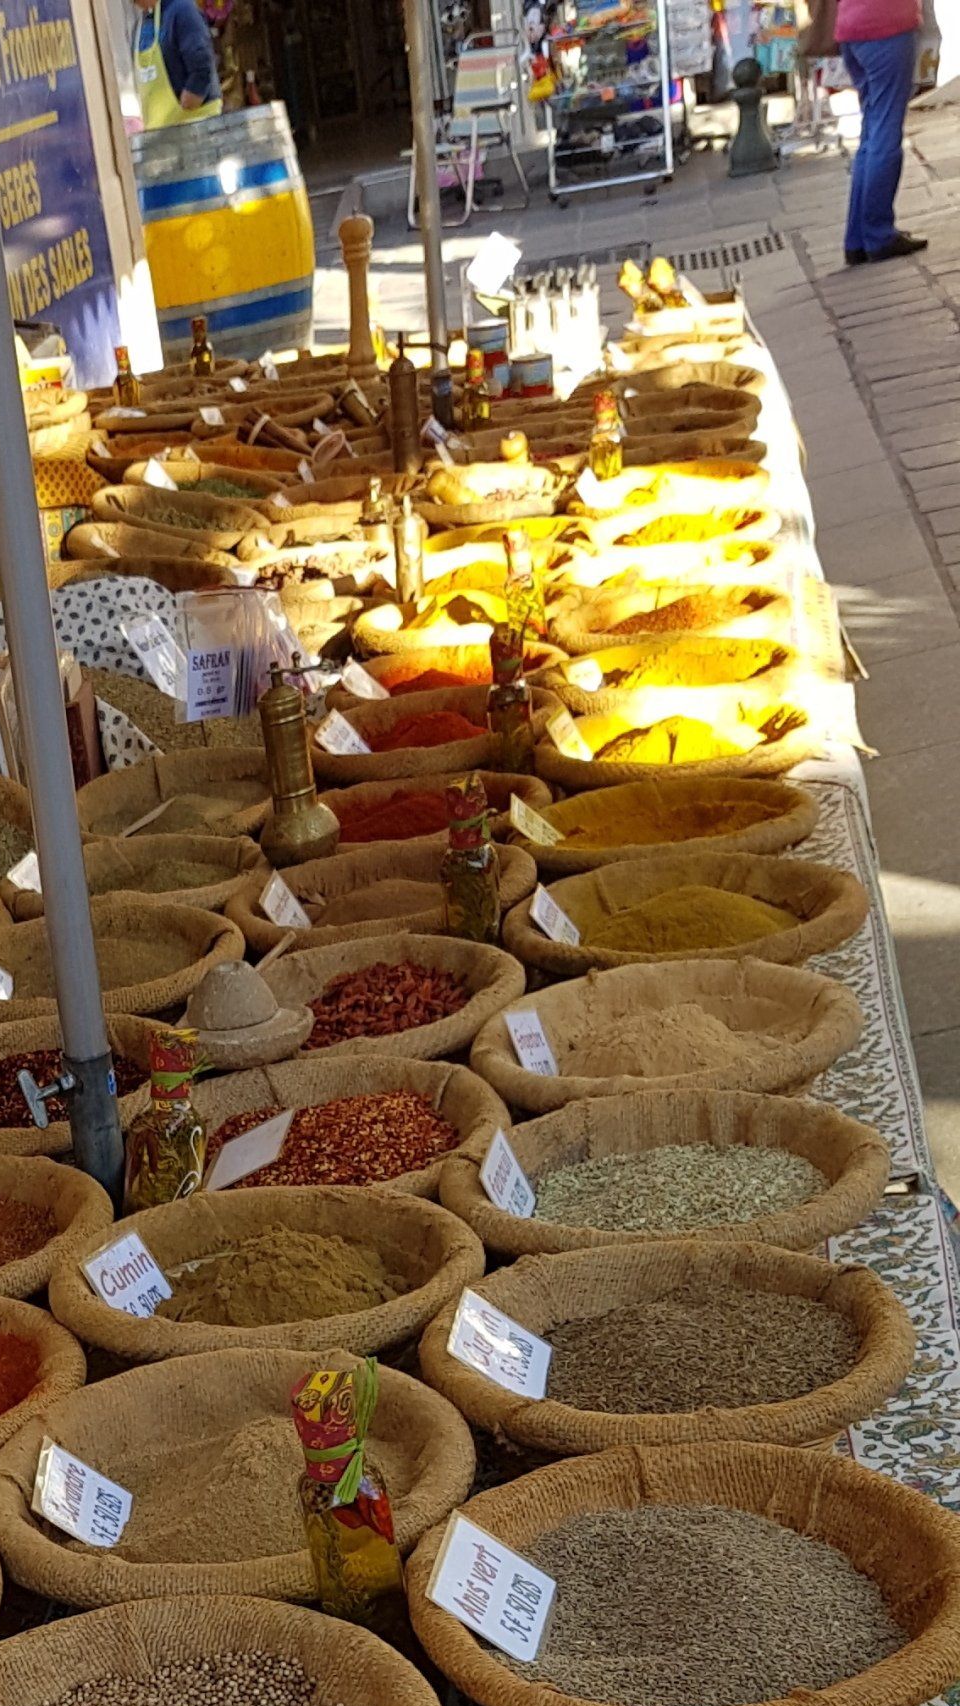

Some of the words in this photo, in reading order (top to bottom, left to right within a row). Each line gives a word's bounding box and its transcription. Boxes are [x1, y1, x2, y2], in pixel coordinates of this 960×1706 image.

[22, 253, 51, 317] DES
[48, 228, 94, 300] SABLES
[101, 1252, 154, 1296] Cumin
[90, 1519, 117, 1545] 5€
[94, 1504, 119, 1528] 50
[471, 1542, 501, 1586] vert
[453, 1579, 490, 1625] Anis
[506, 1593, 537, 1621] 50
[500, 1609, 532, 1643] 5€
